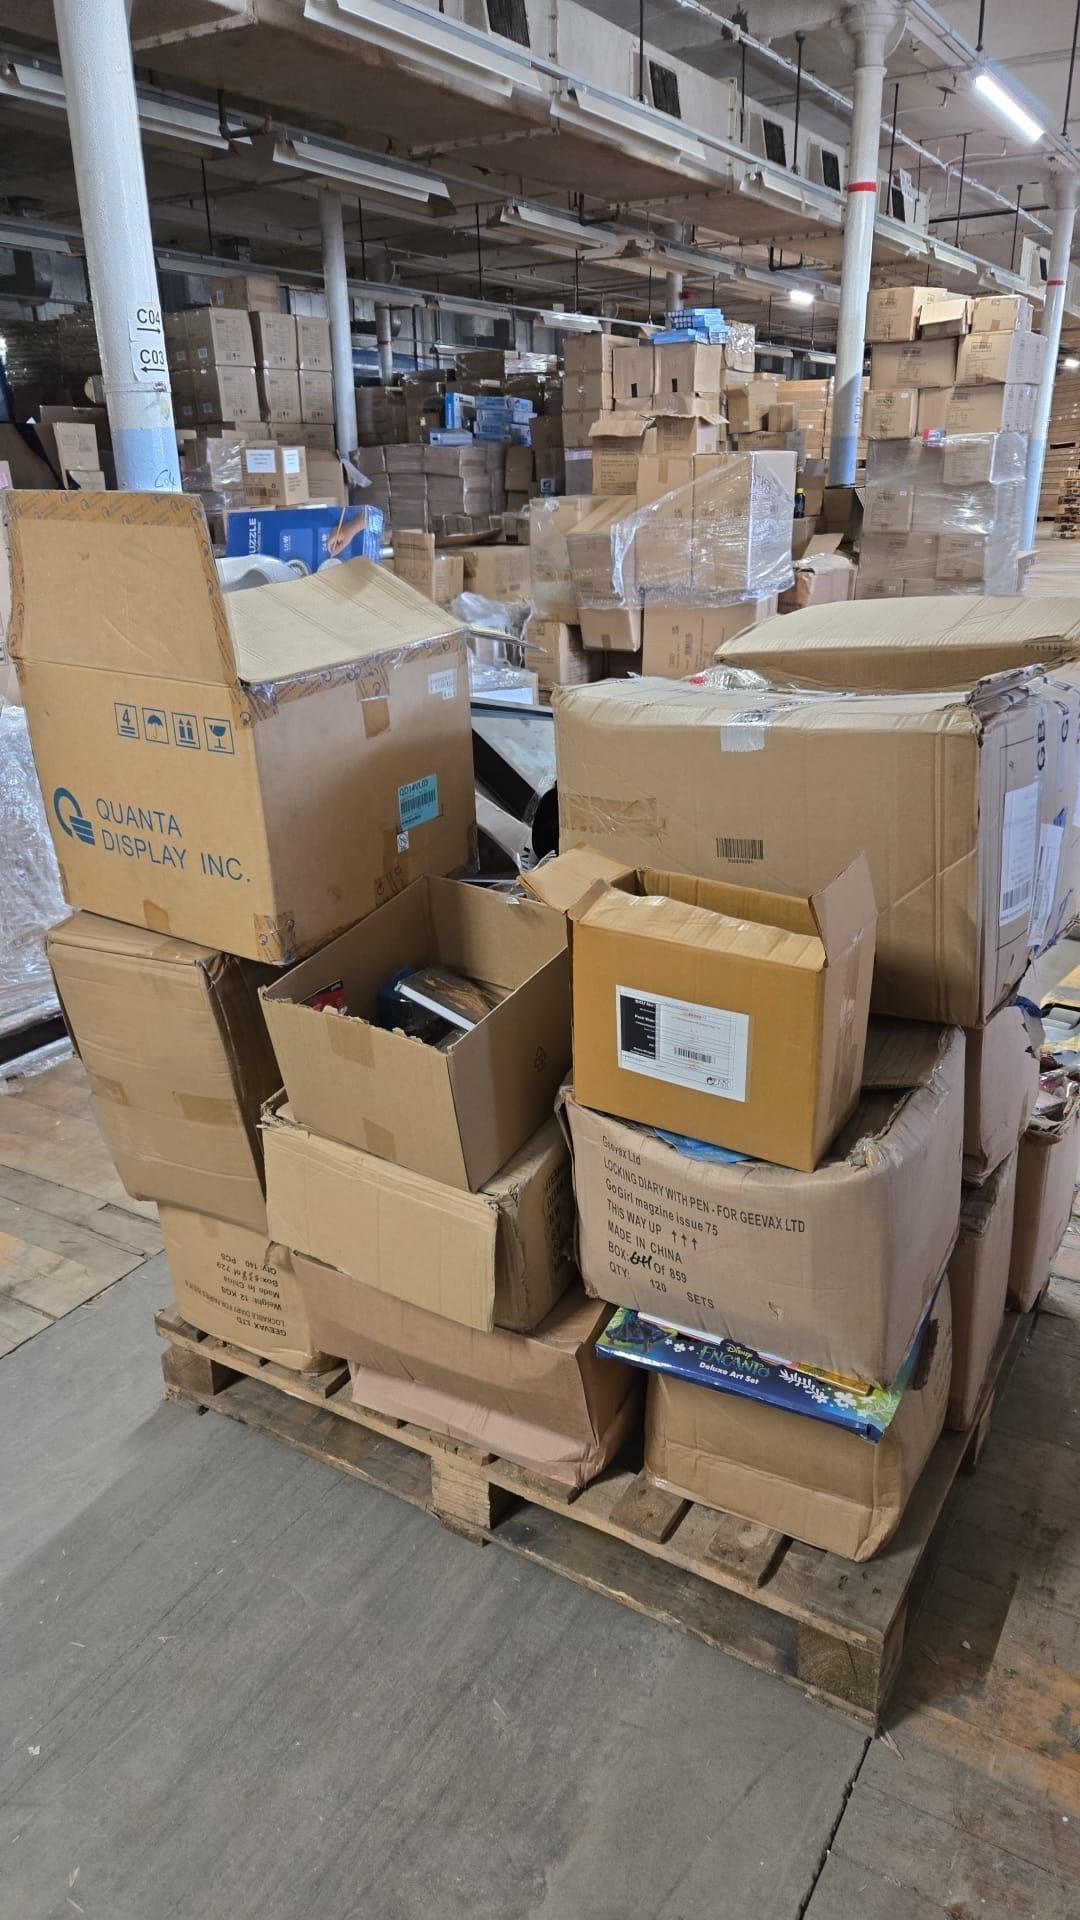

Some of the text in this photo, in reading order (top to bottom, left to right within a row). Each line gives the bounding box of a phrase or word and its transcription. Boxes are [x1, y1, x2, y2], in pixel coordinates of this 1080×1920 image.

[137, 308, 161, 325] C04
[140, 349, 165, 365] C03
[95, 797, 183, 838] QUANTA
[101, 828, 251, 882] DISPLAY INC.
[603, 1154, 637, 1185] LOCKING
[638, 1176, 664, 1197] DIARY
[665, 1186, 688, 1207] WITH
[690, 1195, 710, 1214] PEN
[717, 1204, 738, 1222] FOR
[740, 1211, 783, 1231] GEEVAX
[785, 1218, 806, 1234] LTD
[606, 1198, 662, 1236] THIS WAY UP
[635, 1195, 675, 1222] magzine
[676, 1210, 704, 1232] issue
[705, 1221, 719, 1237] 75
[607, 1219, 683, 1265] MADE IN CHINA
[220, 1252, 236, 1265] PCS
[608, 1240, 630, 1261] BOX:
[669, 1267, 687, 1284] 859
[221, 1285, 237, 1297] KGS
[223, 1275, 245, 1289] China
[258, 1287, 280, 1299] Made
[609, 1260, 715, 1309] QTY: 120 SETS
[240, 1293, 249, 1302] 12
[236, 1316, 287, 1337] GEEVAX LTD
[698, 1345, 770, 1378] ENCANTO
[698, 1361, 760, 1385] Deluxe Art Set
